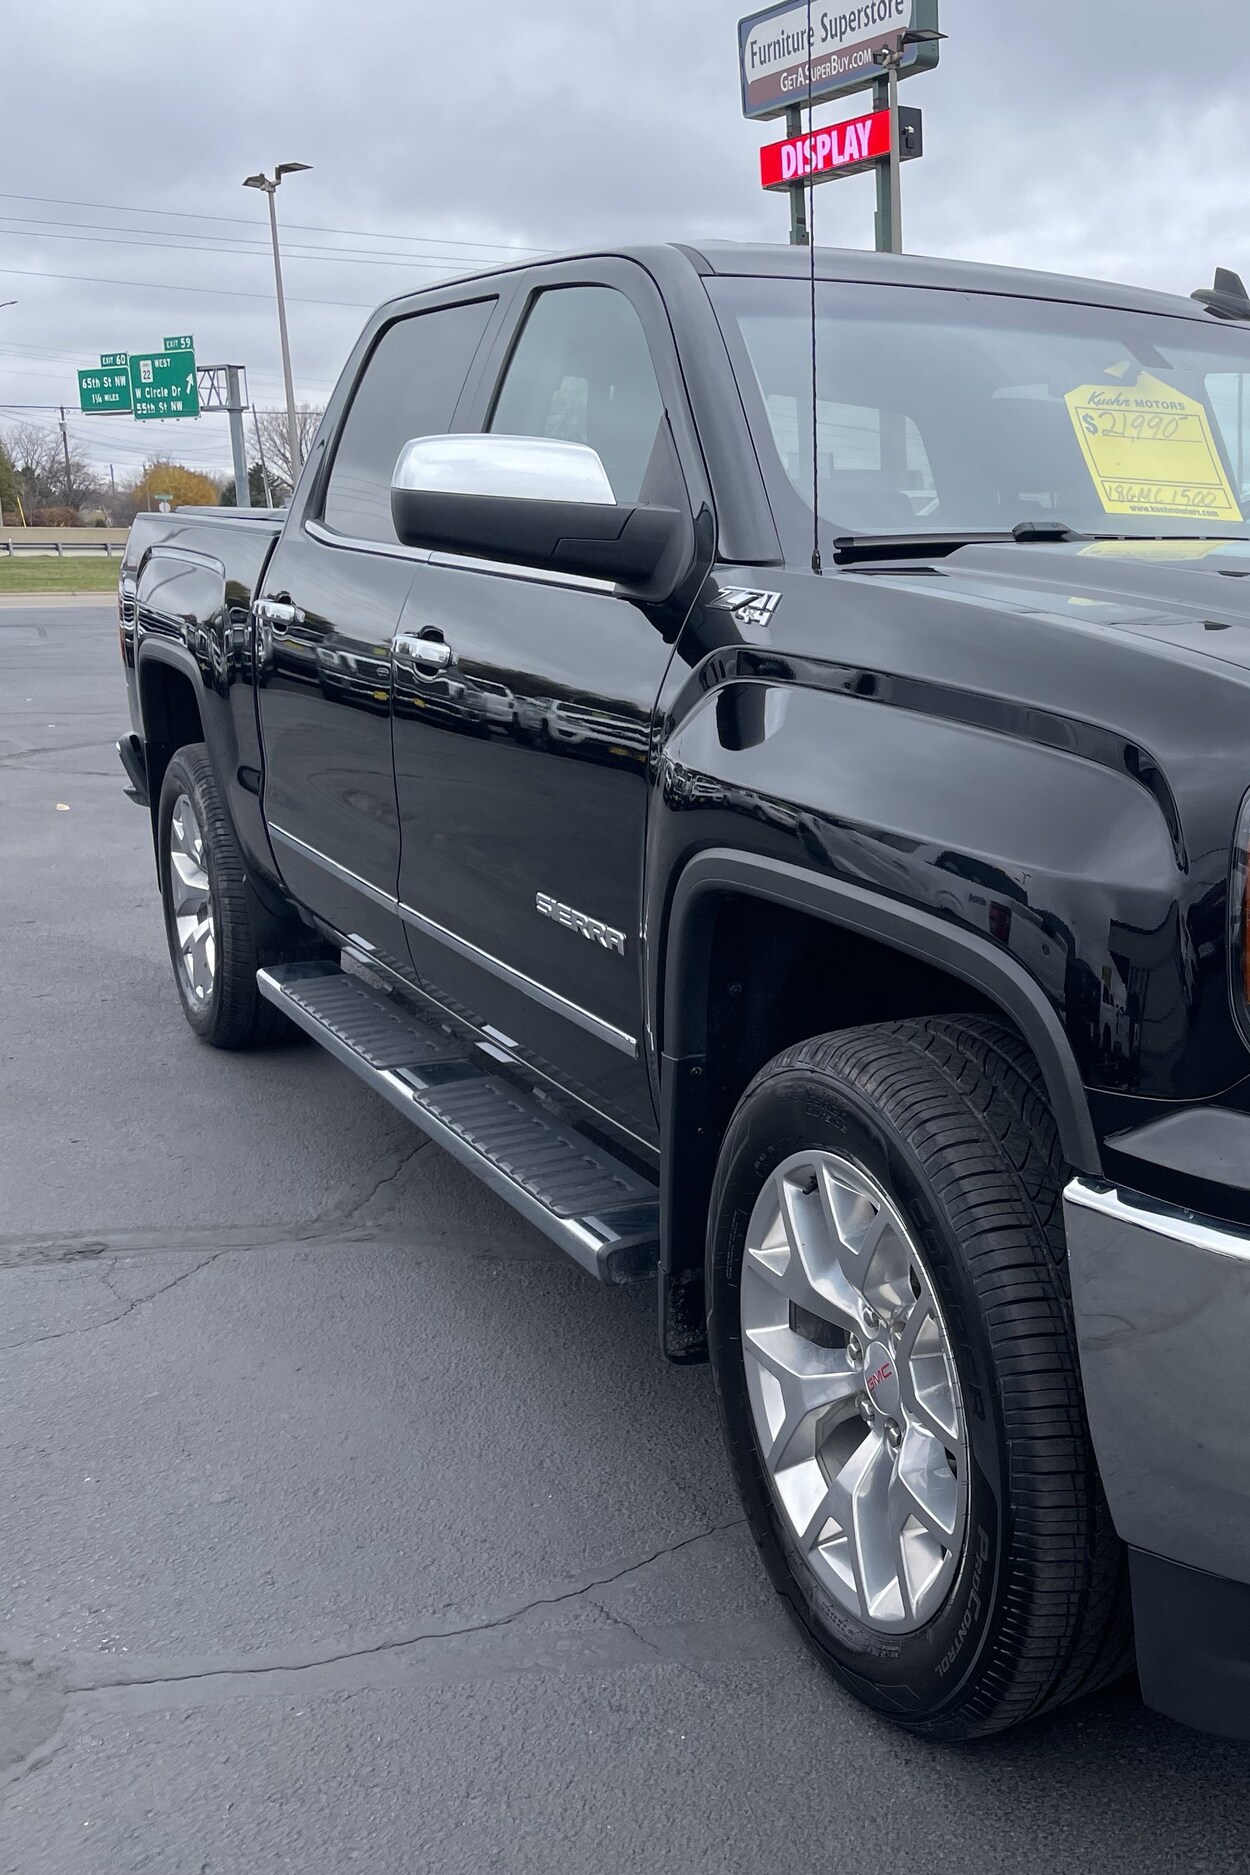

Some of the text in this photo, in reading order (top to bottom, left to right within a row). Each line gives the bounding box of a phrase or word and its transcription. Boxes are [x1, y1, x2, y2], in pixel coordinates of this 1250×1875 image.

[750, 0, 904, 69] Furniture Superstore
[781, 120, 872, 179] DISPLAY
[166, 337, 191, 349] EXIT 59
[102, 354, 126, 365] EXIT 60
[154, 358, 171, 368] WEST
[143, 370, 151, 380] 22
[82, 376, 126, 389] 65th St NW
[104, 394, 119, 402] MILES
[135, 387, 181, 399] W Circle Dr
[136, 401, 183, 414] 55th St NW
[1088, 391, 1186, 411] Kuehn MOTORS
[1172, 488, 1217, 507] 1500
[1129, 504, 1219, 518] www.kuehnmotors.com
[536, 892, 626, 956] SIERRA
[867, 1363, 892, 1392] GMC
